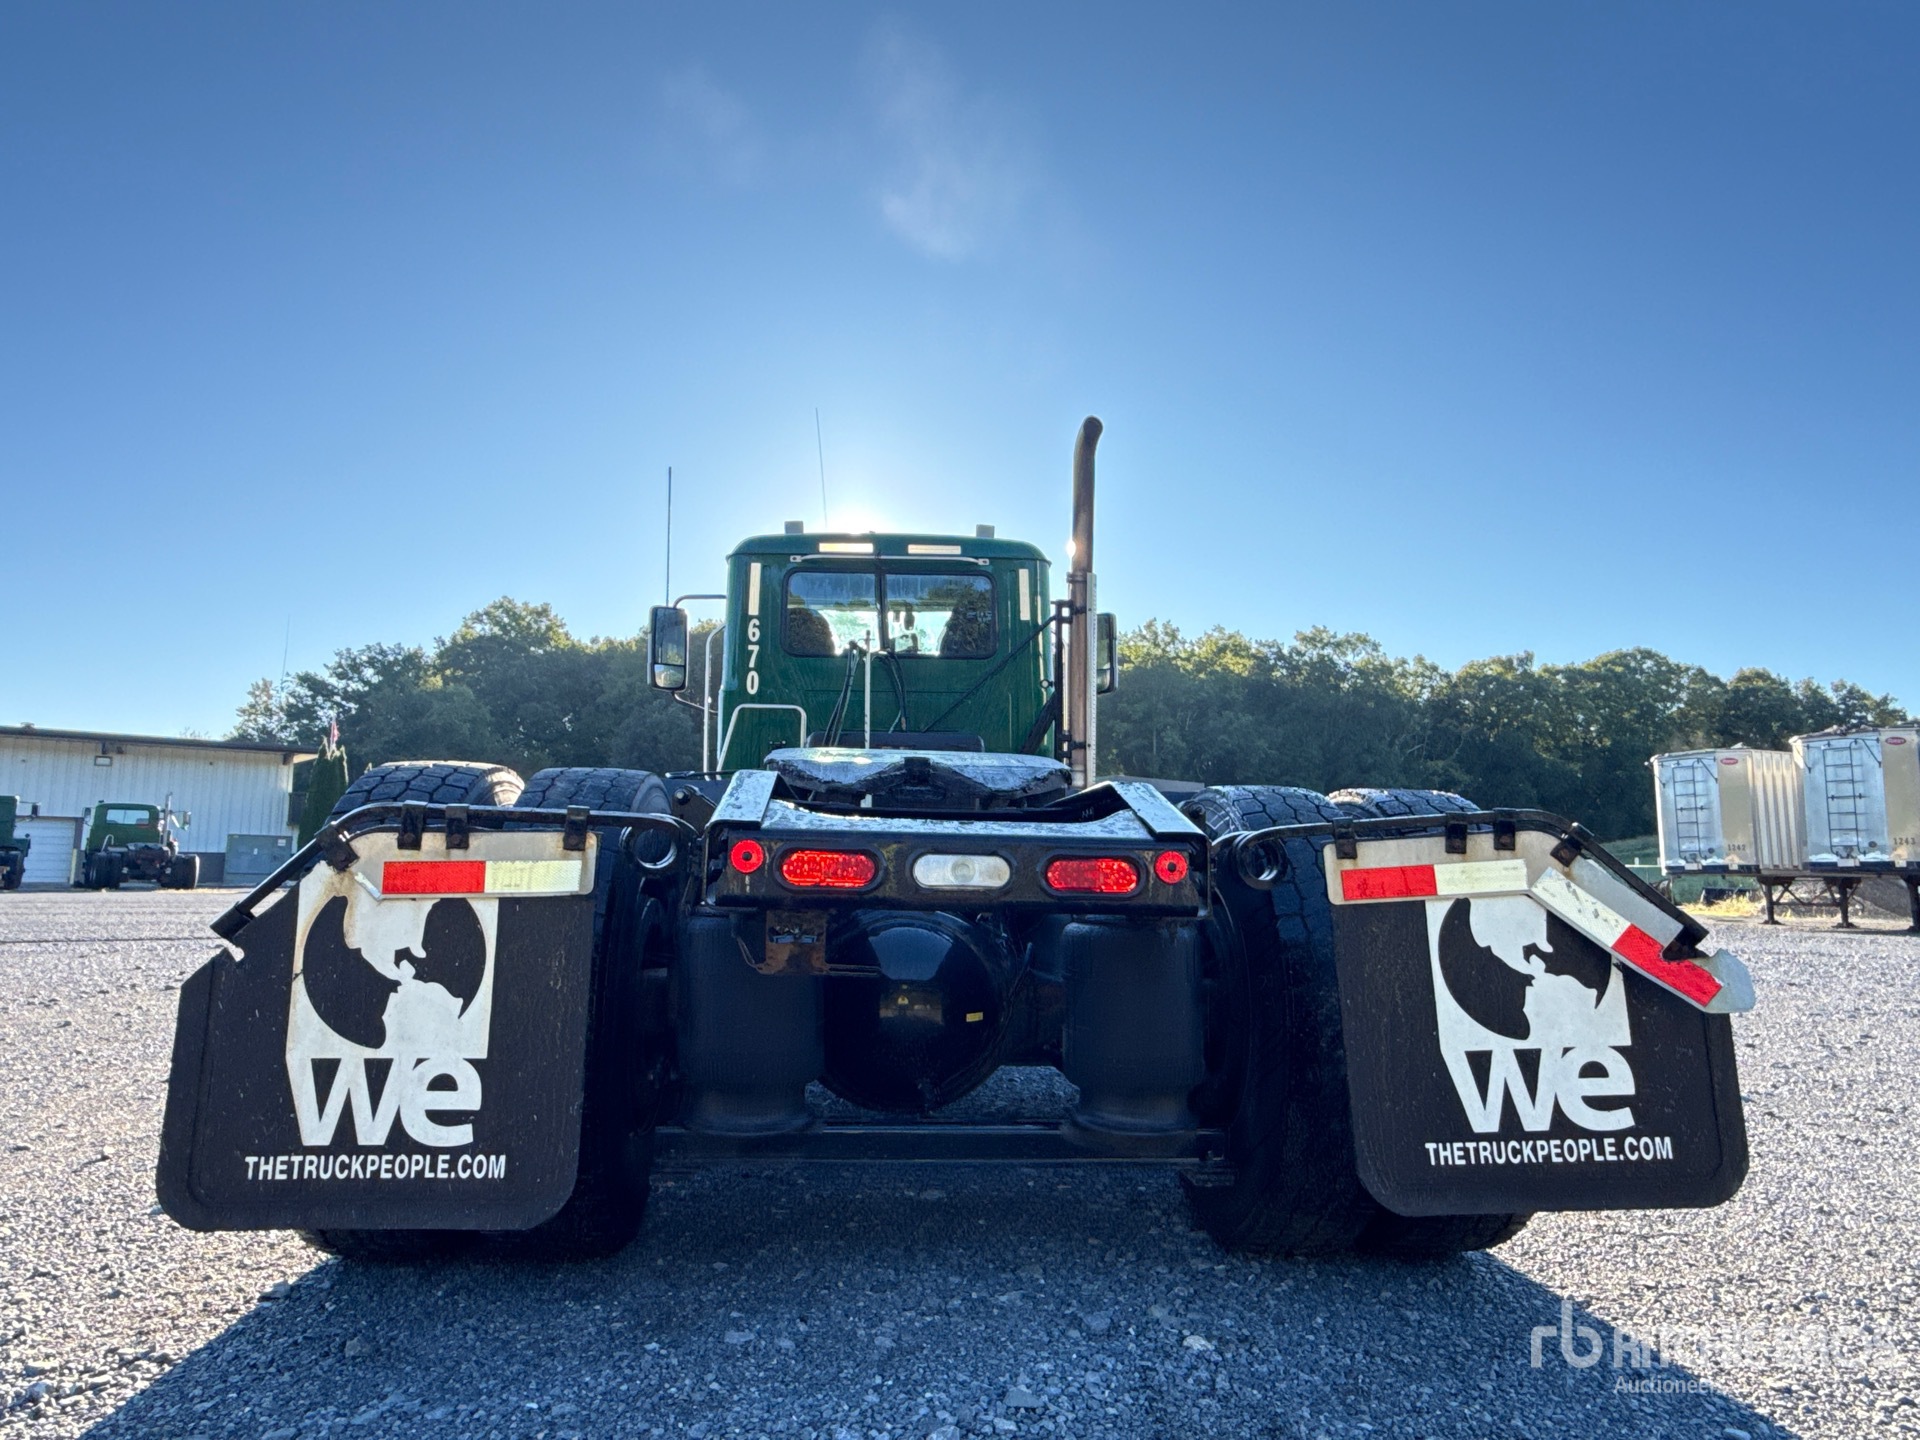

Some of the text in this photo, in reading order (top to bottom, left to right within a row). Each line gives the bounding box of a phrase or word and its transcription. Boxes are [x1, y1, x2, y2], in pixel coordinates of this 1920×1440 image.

[746, 618, 760, 695] 670
[1893, 837, 1916, 845] 1243
[1425, 1136, 1673, 1166] THETRUCKPEOPLE.COM
[245, 1154, 506, 1181] THETRUCKPEOPLE.COM
